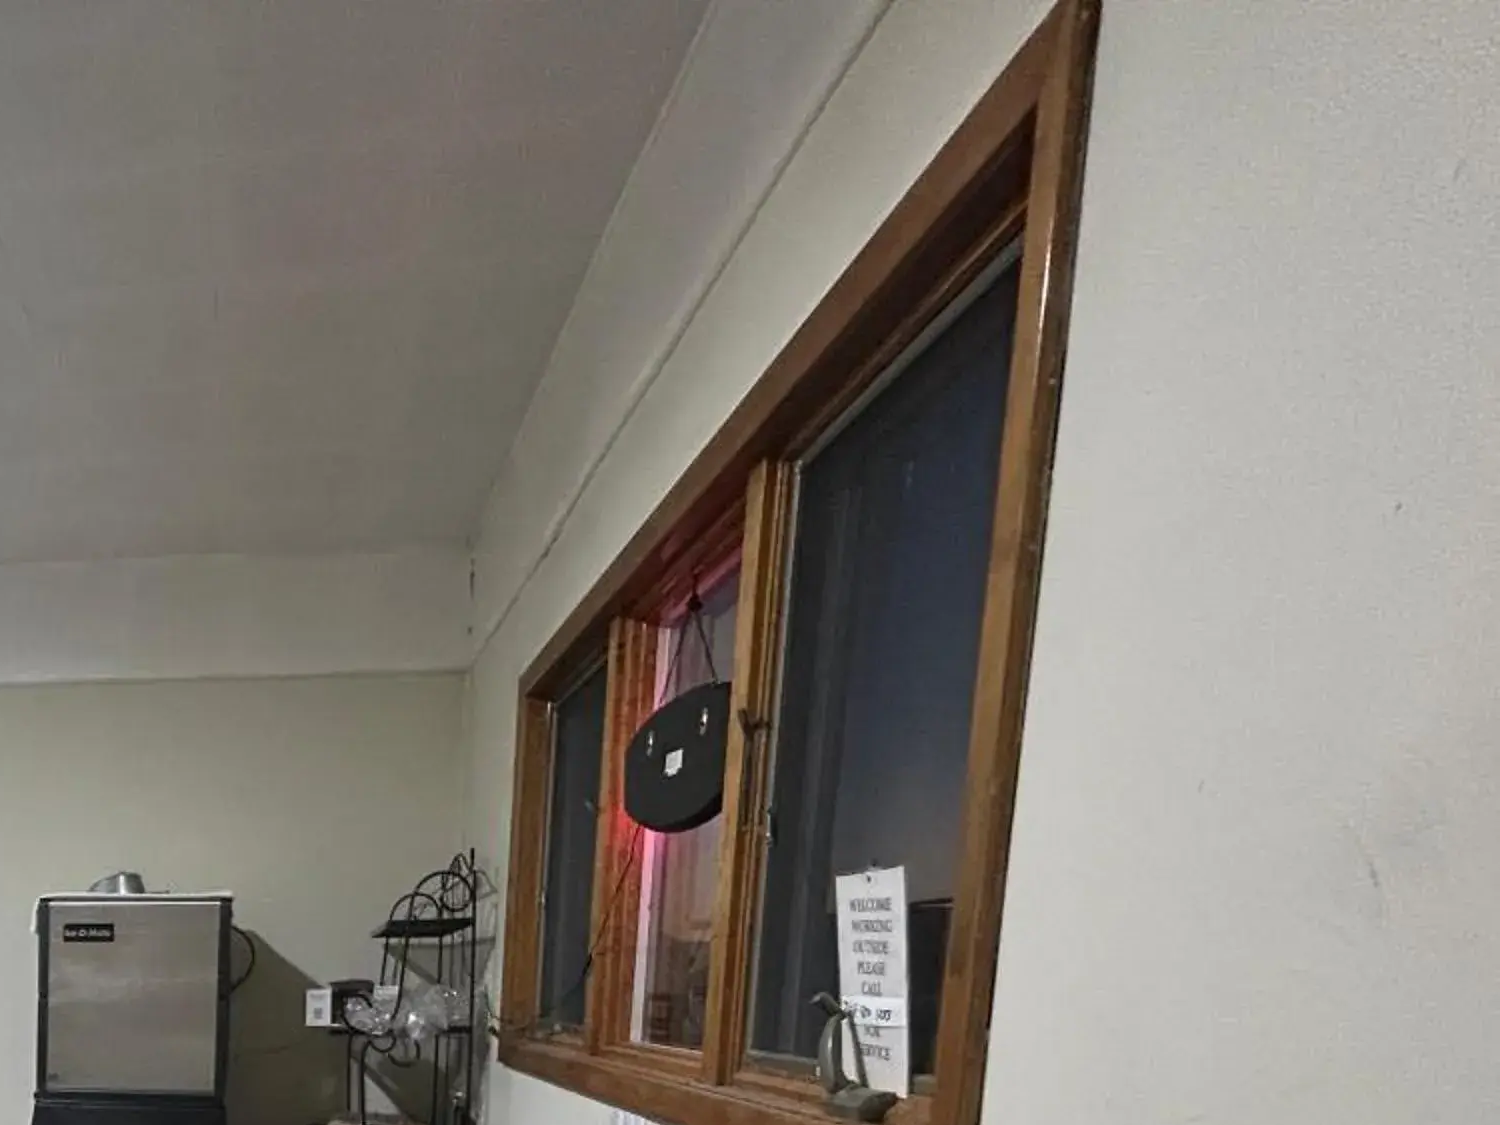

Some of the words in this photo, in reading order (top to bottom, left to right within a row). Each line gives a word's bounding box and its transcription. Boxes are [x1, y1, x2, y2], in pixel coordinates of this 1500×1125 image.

[850, 897, 892, 912] WELCOME
[851, 919, 893, 933] WORKING
[853, 940, 889, 955] OUTSIDE
[857, 962, 886, 976] PLEASE
[860, 980, 883, 997] CALL
